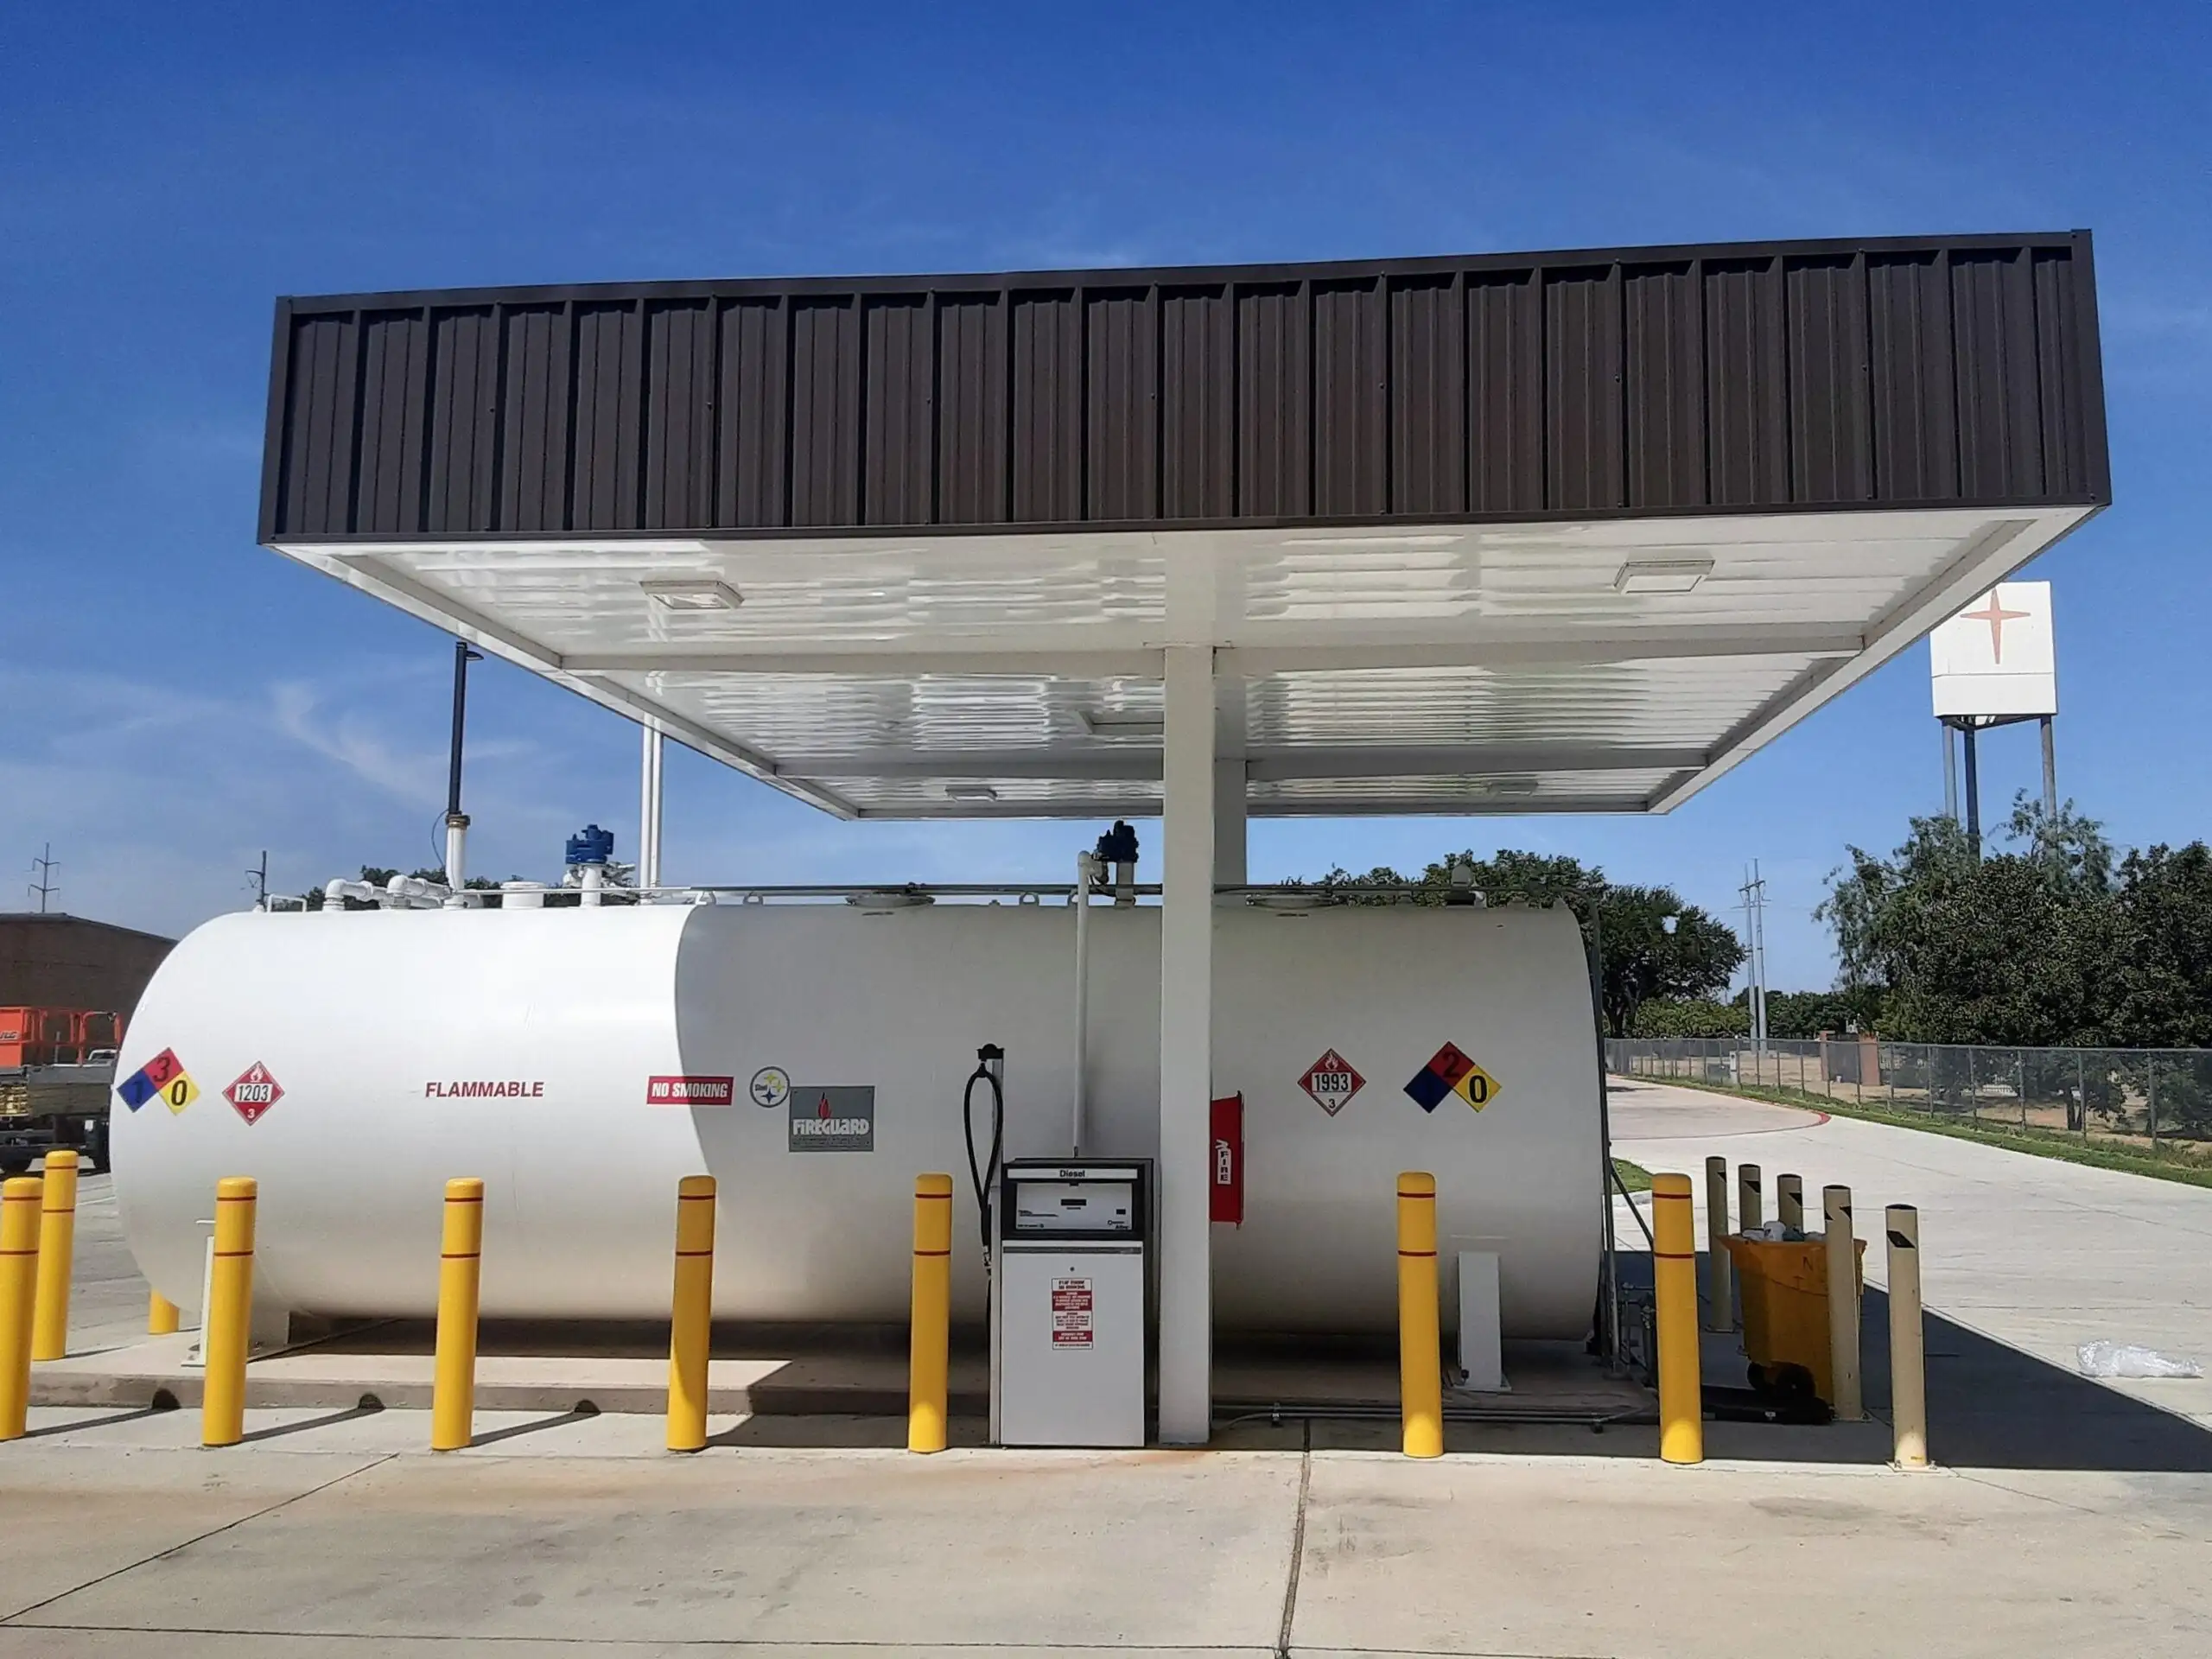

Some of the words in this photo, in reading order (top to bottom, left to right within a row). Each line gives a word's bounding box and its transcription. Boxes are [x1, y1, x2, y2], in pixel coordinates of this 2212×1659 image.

[153, 1057, 170, 1082] 3
[1442, 1052, 1460, 1078] 2
[425, 1081, 544, 1098] FLAMMABLE
[652, 1083, 670, 1097] NO
[671, 1083, 728, 1099] SMOKING
[1314, 1073, 1349, 1092] 1993
[1469, 1075, 1487, 1103] 0
[171, 1080, 188, 1106] 0
[238, 1084, 269, 1102] 1203
[1328, 1098, 1336, 1109] 3
[248, 1108, 256, 1118] 3
[1059, 1169, 1085, 1178] Diesel
